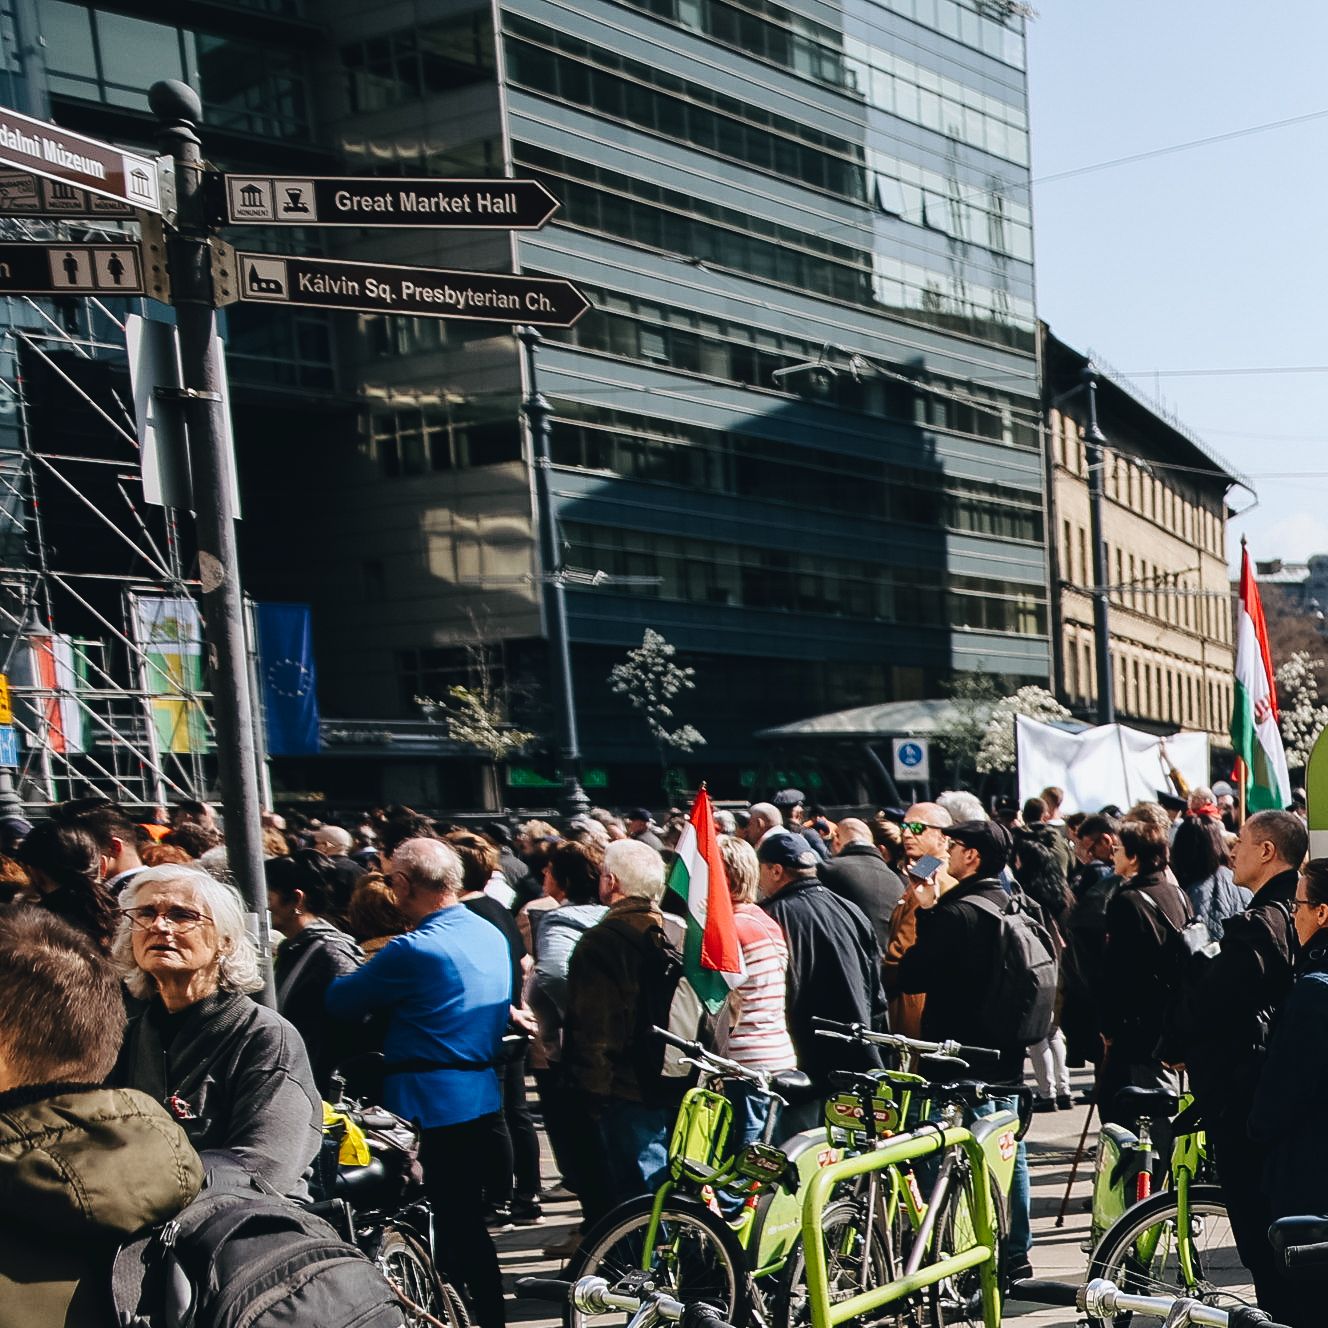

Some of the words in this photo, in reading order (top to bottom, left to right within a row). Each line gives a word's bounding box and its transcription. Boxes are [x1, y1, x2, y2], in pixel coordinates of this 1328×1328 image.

[43, 138, 106, 180] Múzeum
[335, 190, 393, 211] Great
[400, 192, 471, 213] Market
[476, 193, 517, 213] Hall
[299, 273, 359, 296] Kálvin
[365, 279, 397, 303] Sq.
[402, 281, 520, 310] Presbyterian
[525, 292, 557, 312] Ch.
